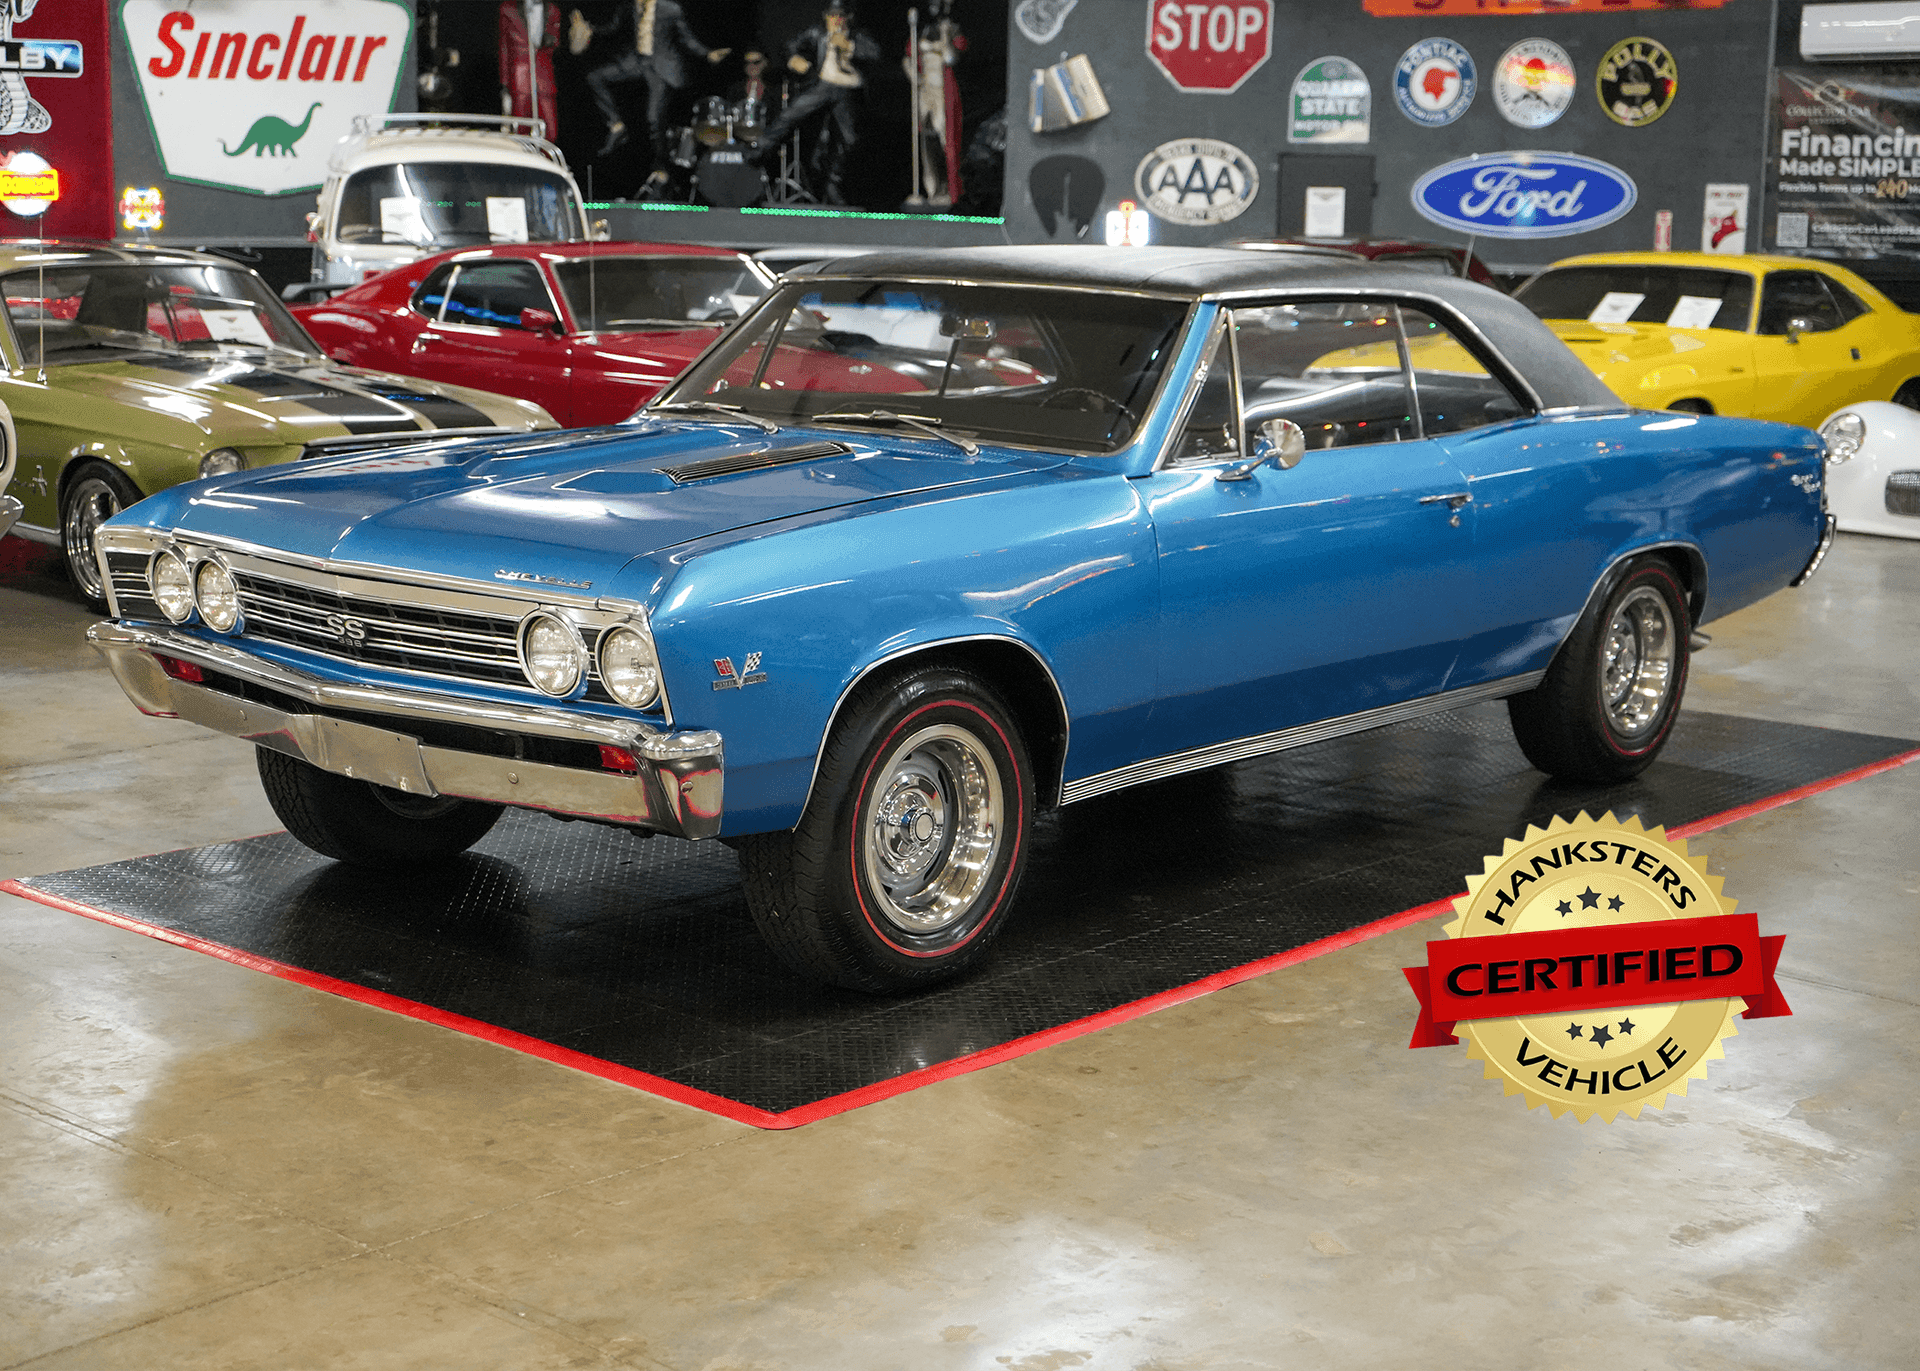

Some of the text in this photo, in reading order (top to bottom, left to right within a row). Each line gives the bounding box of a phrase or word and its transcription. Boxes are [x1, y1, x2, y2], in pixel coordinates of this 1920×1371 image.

[1156, 3, 1264, 52] STOP
[148, 11, 388, 82] Sinclair
[1400, 43, 1468, 74] PONTIAC
[1602, 43, 1673, 82] POLLY
[1301, 98, 1360, 115] STATE
[1158, 157, 1235, 205] AAA
[1779, 157, 1920, 178] Made SIMPLE
[1459, 165, 1588, 218] Ford
[1779, 181, 1817, 193] Flexible
[1818, 182, 1848, 193] Terms
[326, 615, 366, 639] SS
